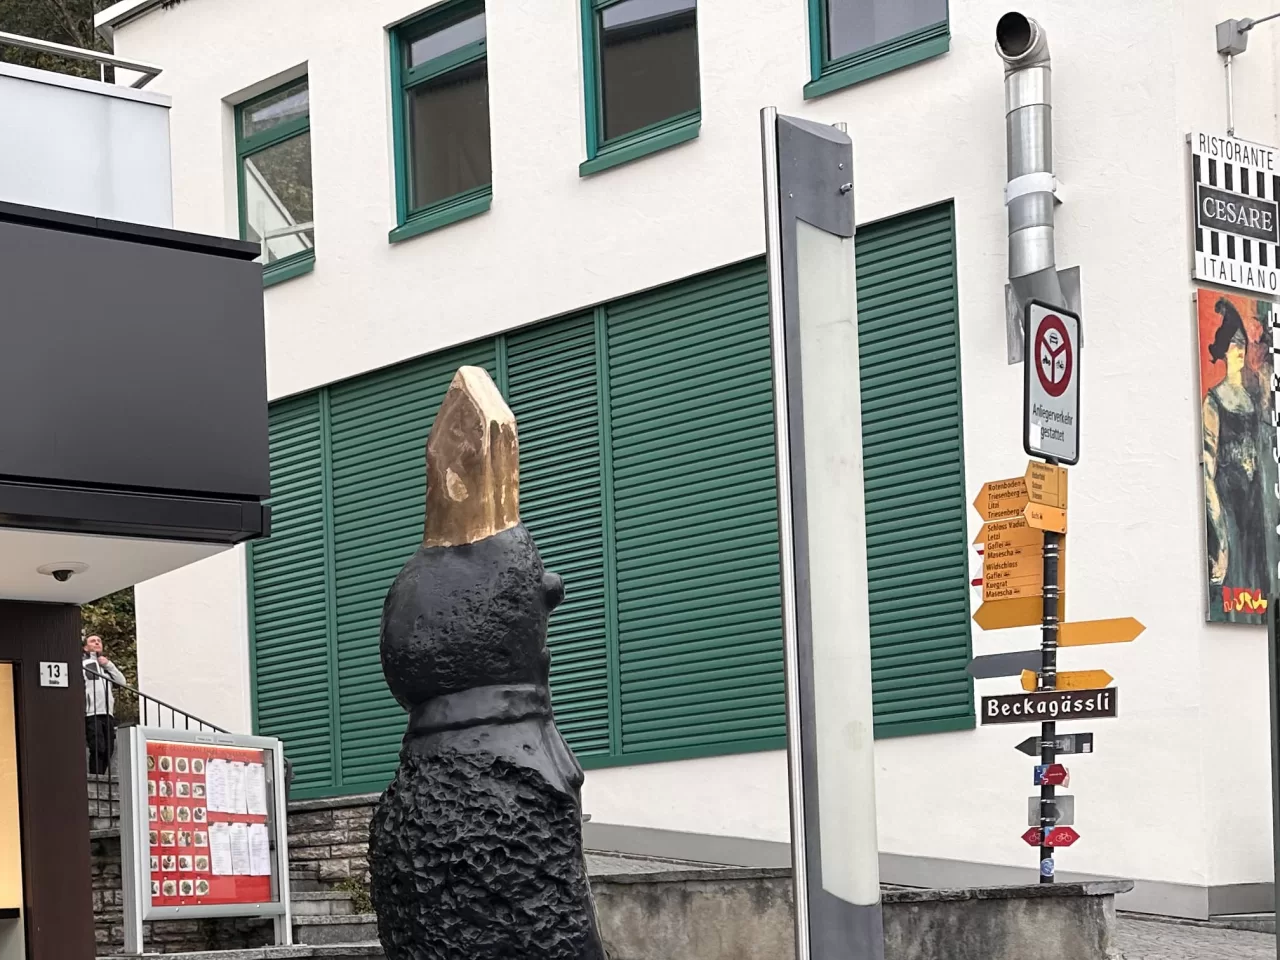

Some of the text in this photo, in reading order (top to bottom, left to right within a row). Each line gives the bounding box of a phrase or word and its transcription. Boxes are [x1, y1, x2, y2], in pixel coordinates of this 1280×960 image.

[1199, 132, 1275, 171] RISTORANTE
[1202, 196, 1274, 232] CESARE
[1203, 256, 1278, 291] ITALIANO
[1040, 426, 1065, 442] gestattet
[988, 490, 1020, 501] Triesenberg
[987, 508, 1020, 519] Triesenberg
[987, 520, 1026, 533] Schloss Vaduz
[986, 561, 1018, 571] Wildschloss
[985, 588, 1013, 599] Masescha
[47, 664, 61, 679] 13
[987, 693, 1109, 716] Beckagässli
